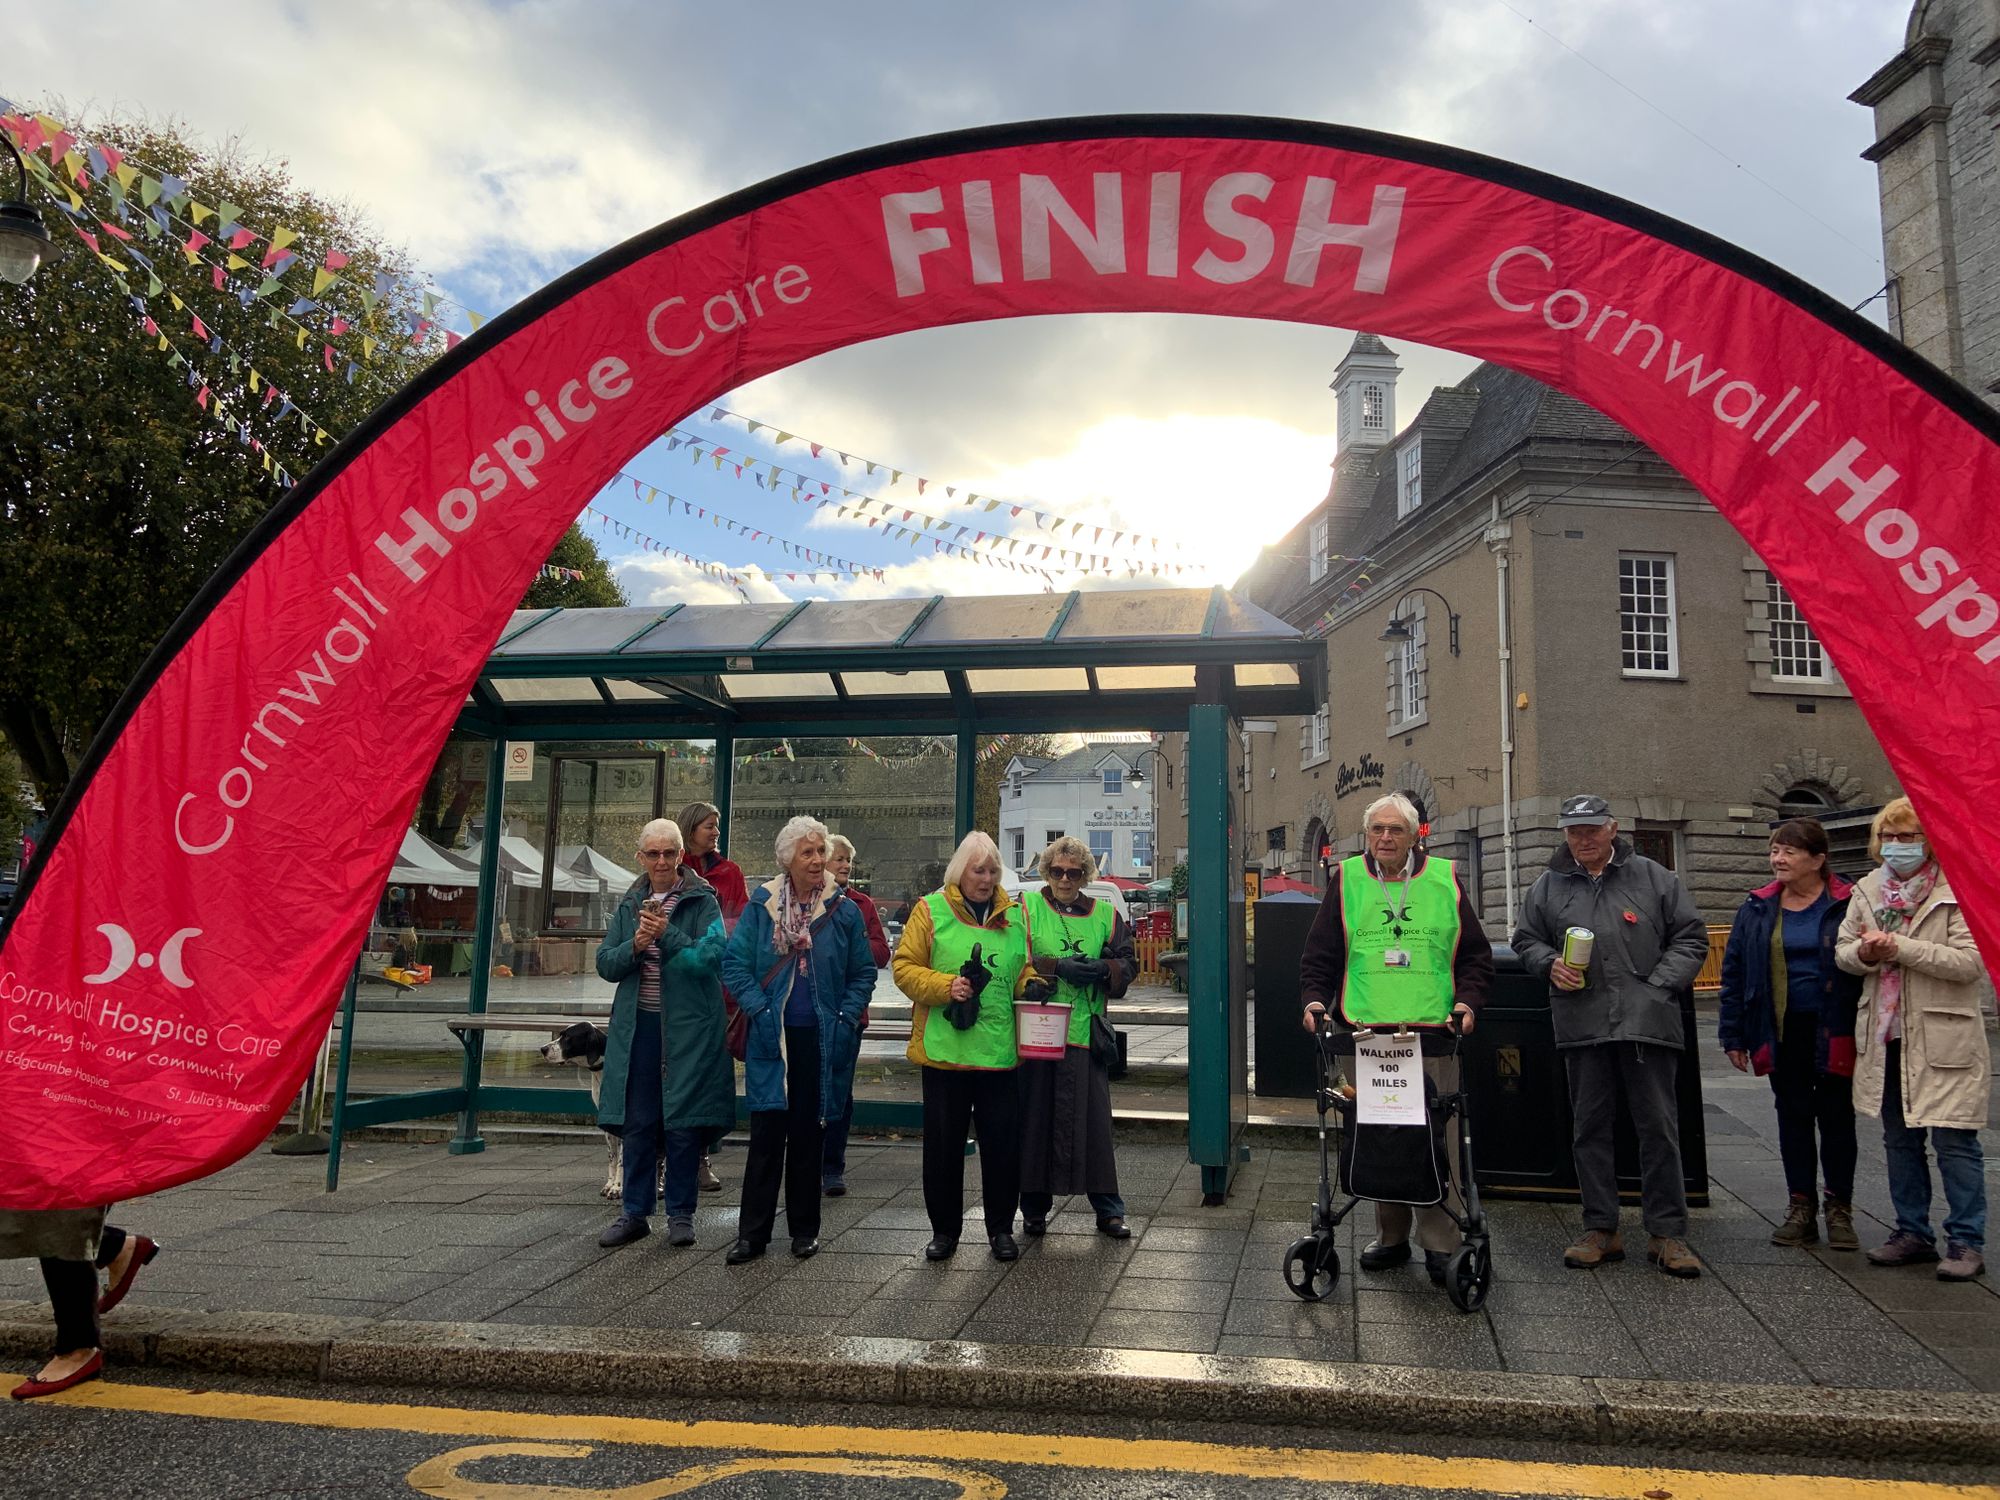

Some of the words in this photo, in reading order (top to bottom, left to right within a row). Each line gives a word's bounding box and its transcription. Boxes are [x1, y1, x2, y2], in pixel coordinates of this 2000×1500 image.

[881, 171, 1407, 297] FINISH
[1487, 245, 1820, 457] Cornwall
[174, 572, 389, 855] Cornwall
[374, 355, 633, 583] Hospice
[646, 264, 812, 357] Care
[0, 971, 94, 1022] Cornwall
[98, 999, 208, 1046] Hospice
[217, 1023, 281, 1058] Care
[5, 1050, 72, 1077] Edgcumbe
[75, 1067, 110, 1088] Hospice
[8, 1014, 74, 1052] Caring
[80, 1032, 98, 1052] for
[105, 1046, 137, 1062] our
[146, 1053, 244, 1091] community
[1360, 1047, 1414, 1059] WALKING
[1379, 1064, 1399, 1073] 100
[185, 1090, 223, 1109] Julia's
[1372, 1078, 1407, 1088] MILES
[115, 1107, 132, 1119] No.
